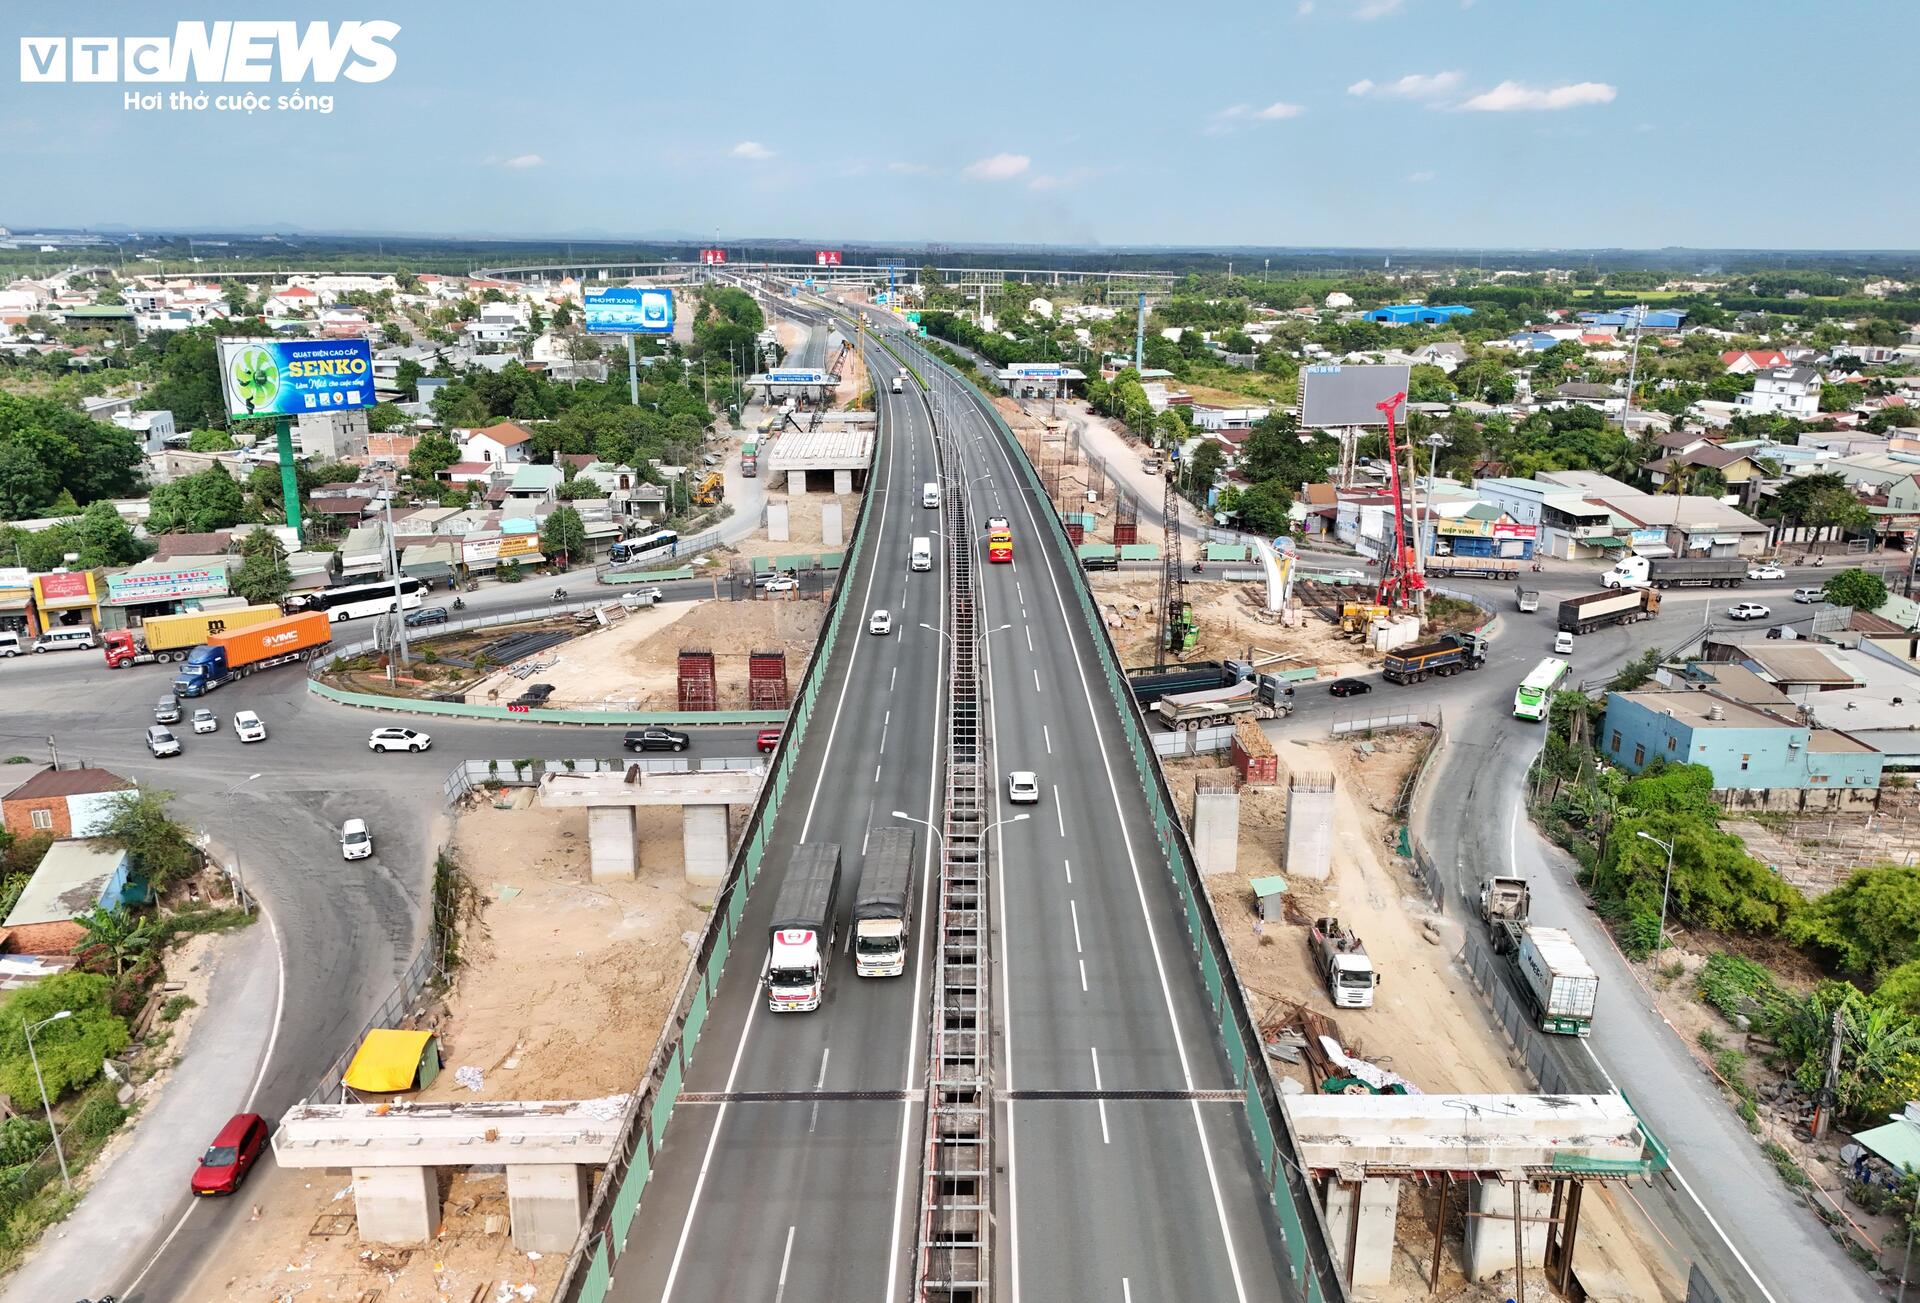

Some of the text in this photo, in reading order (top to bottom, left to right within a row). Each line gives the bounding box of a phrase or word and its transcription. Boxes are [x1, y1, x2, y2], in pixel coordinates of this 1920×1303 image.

[293, 351, 311, 359] QUẠT
[312, 350, 329, 358] ĐIỆN
[344, 347, 358, 356] CẤP
[288, 358, 367, 377] SENKO
[123, 574, 171, 584] MINH
[176, 571, 210, 579] HUY
[271, 630, 298, 643] VIMC
